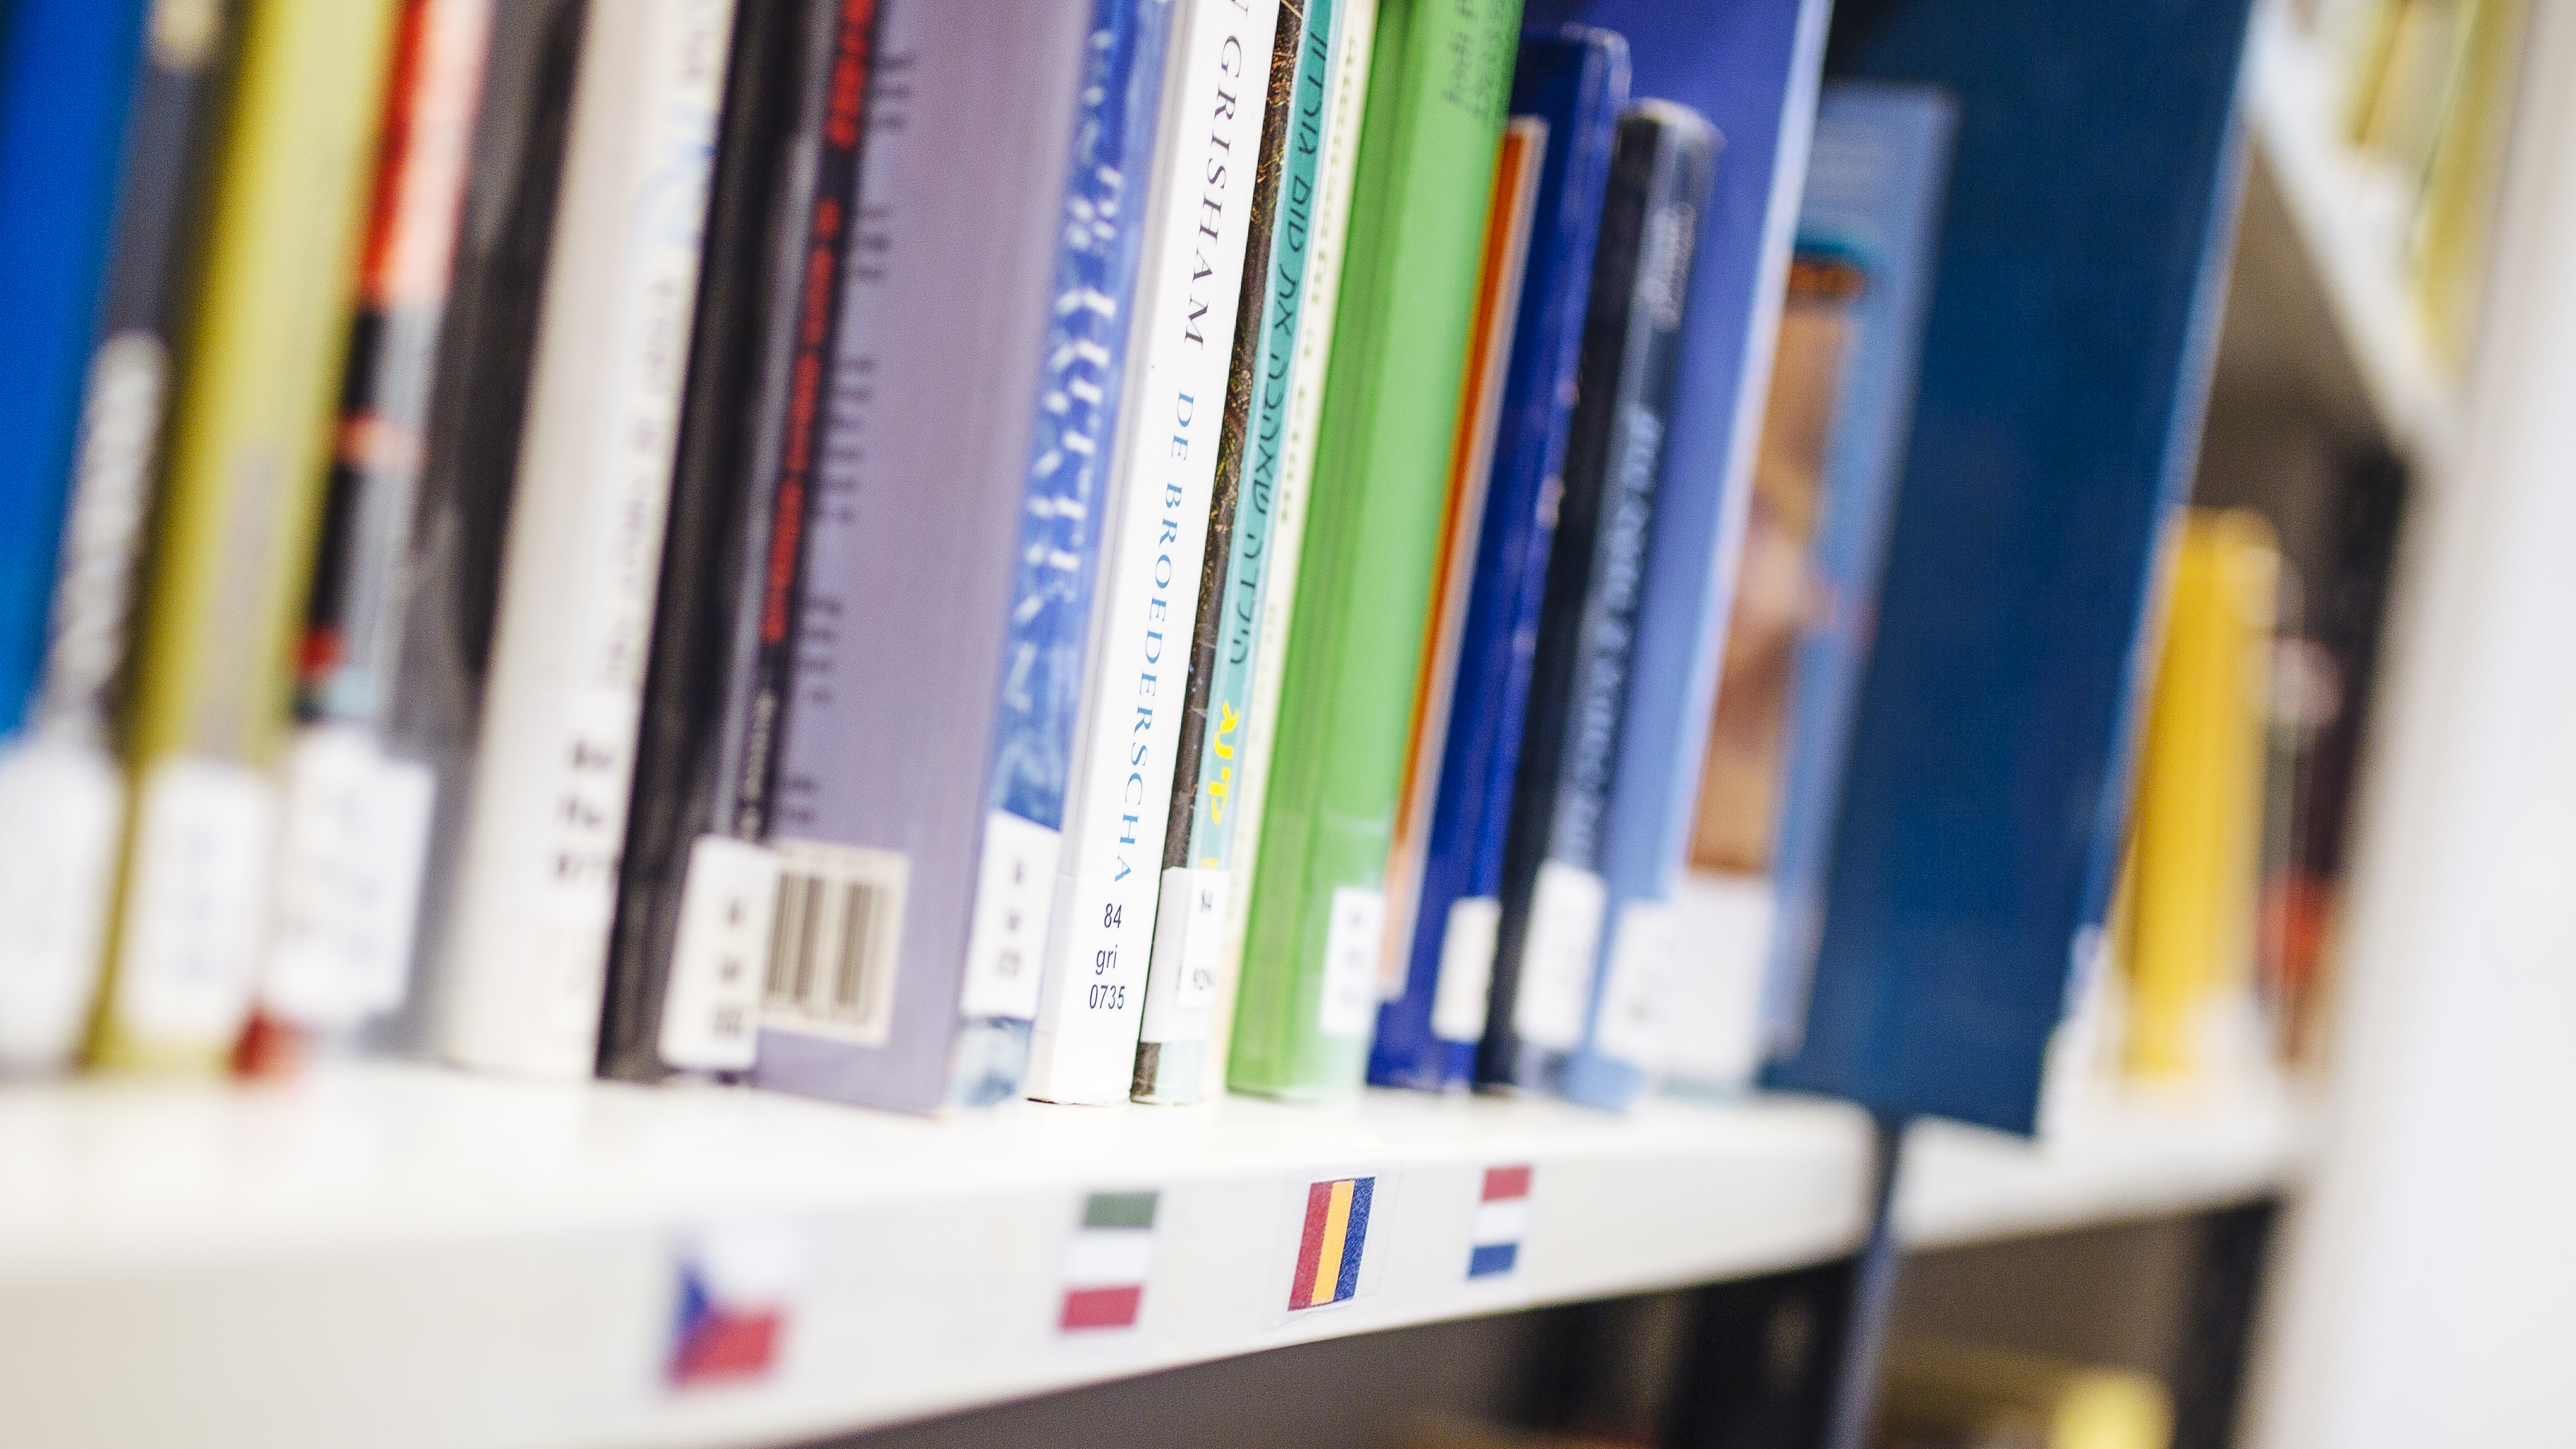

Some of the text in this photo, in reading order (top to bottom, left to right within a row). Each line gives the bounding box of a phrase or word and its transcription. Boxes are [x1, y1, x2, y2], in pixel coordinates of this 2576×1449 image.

[1185, 36, 1241, 350] GRISHAM
[1208, 700, 1239, 826] קינג
[1230, 532, 1264, 664] הילדה
[1252, 353, 1289, 515] שאהבה
[1274, 264, 1297, 338] את
[1287, 175, 1311, 253] טום
[1299, 31, 1328, 155] גורדון
[1115, 391, 1195, 882] DE BROEDERSCHA
[1089, 983, 1125, 1010] 0735
[1095, 944, 1118, 976] gri
[1104, 902, 1122, 929] 84
